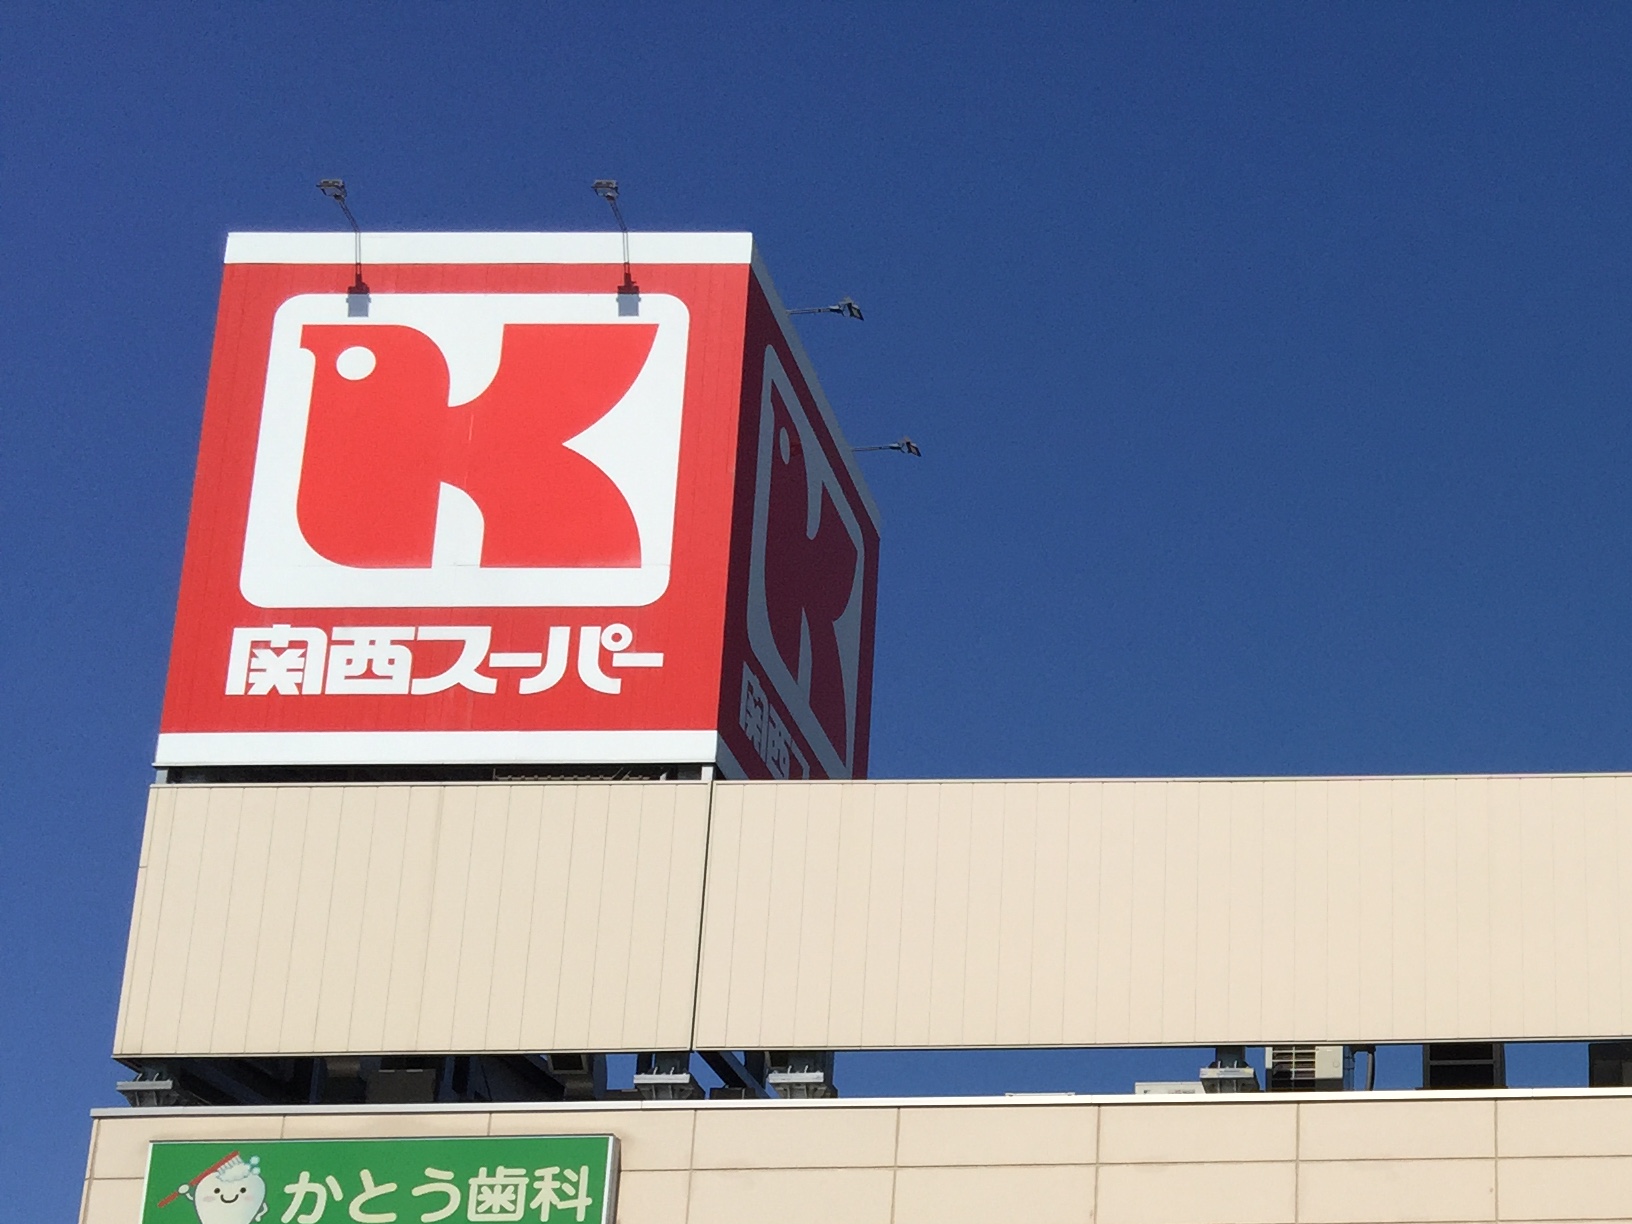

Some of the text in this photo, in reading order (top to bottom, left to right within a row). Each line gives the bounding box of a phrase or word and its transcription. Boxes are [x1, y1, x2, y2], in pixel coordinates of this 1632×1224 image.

[225, 623, 664, 696] 関西スーパー
[281, 1165, 593, 1224] かとう歯科
